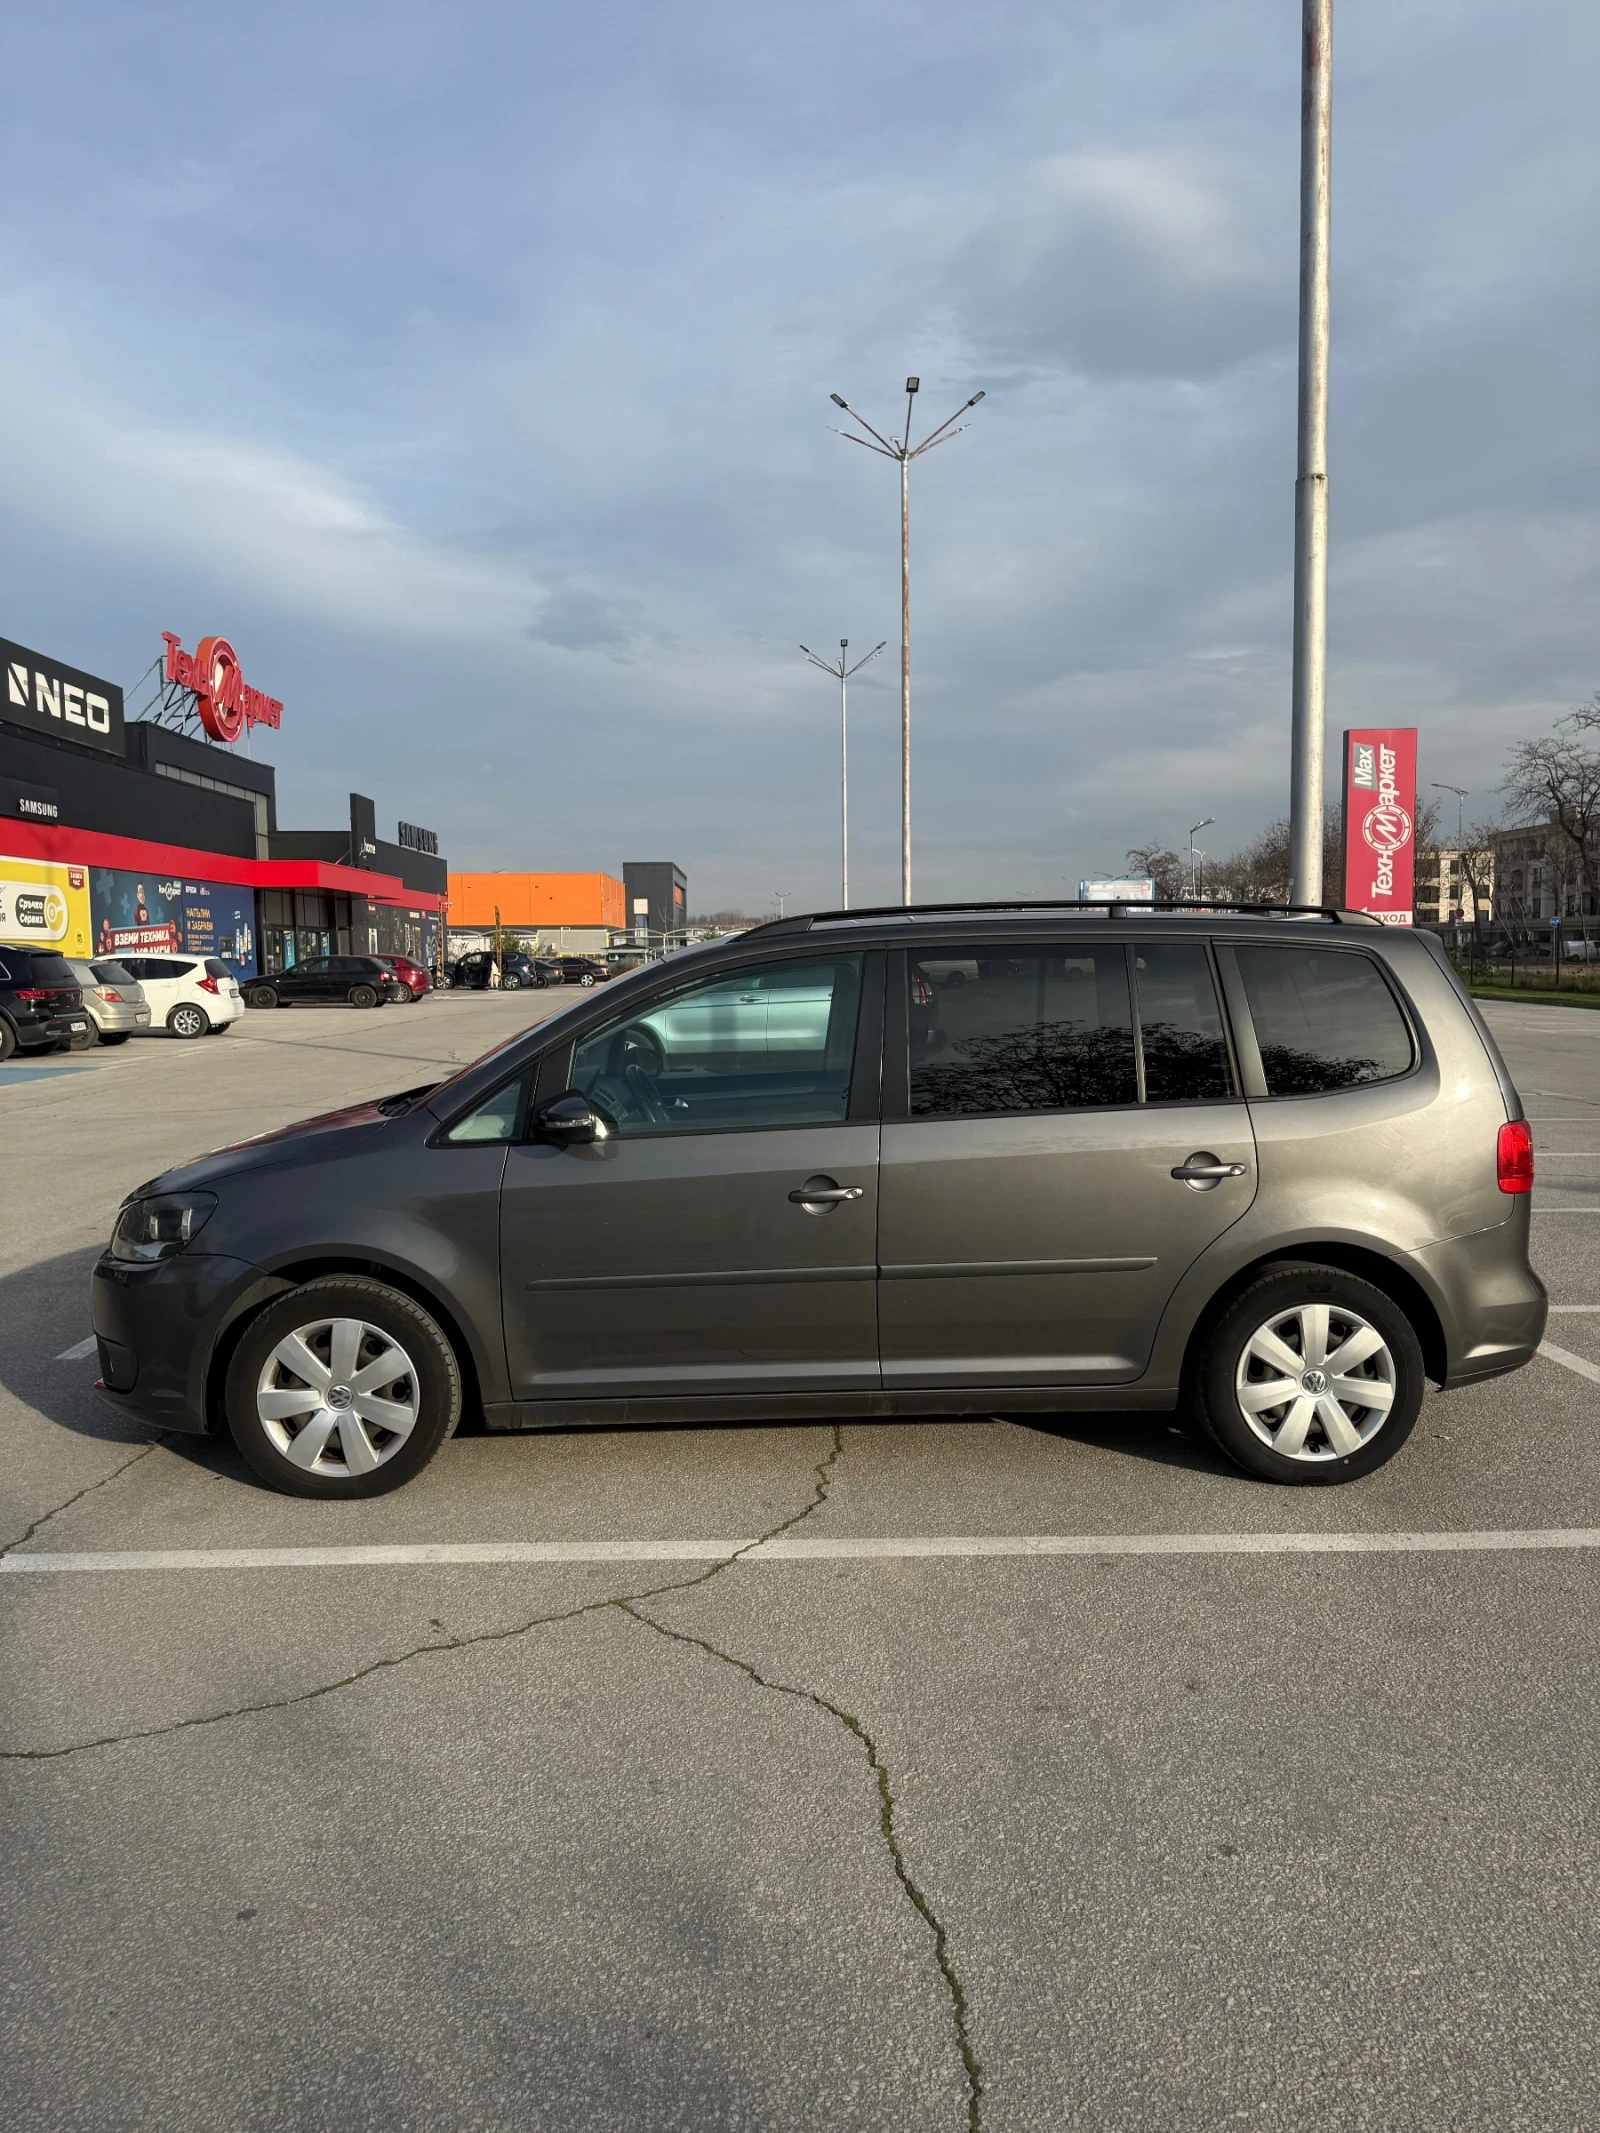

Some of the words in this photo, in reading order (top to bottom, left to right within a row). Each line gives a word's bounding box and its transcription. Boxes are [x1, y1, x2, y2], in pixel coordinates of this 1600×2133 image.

[35, 671, 110, 734] NEO
[1354, 747, 1373, 787] Max
[19, 797, 58, 818] SAMSUNG
[397, 820, 439, 855] SAMSUNG
[19, 898, 43, 910] Сръчко
[19, 913, 43, 925] Сервиз
[114, 932, 139, 946] ВЗЕМИ
[140, 930, 170, 944] ТЕХНИКА
